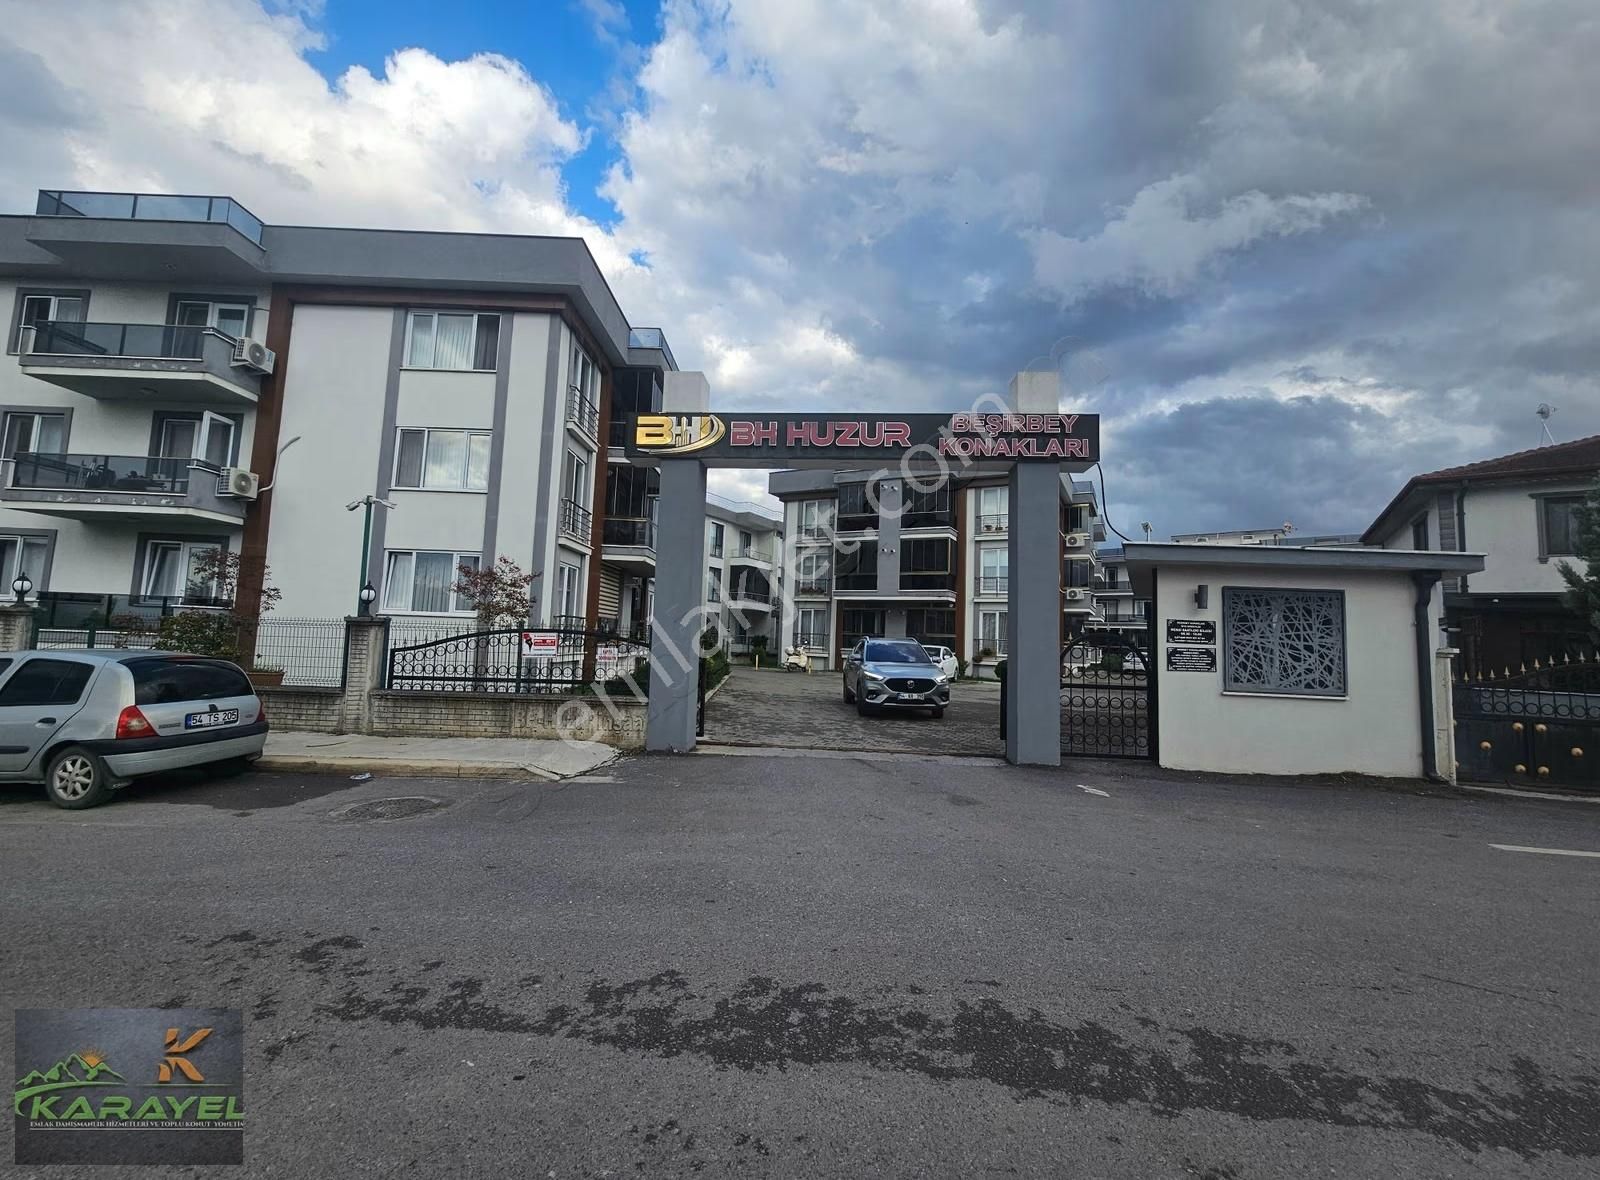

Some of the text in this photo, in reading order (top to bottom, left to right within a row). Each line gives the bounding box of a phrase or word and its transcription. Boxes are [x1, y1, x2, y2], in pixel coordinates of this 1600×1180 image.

[730, 420, 911, 447] BH HUZUR
[939, 437, 1089, 457] KONAKLARI
[192, 714, 203, 725] 54
[208, 712, 220, 723] TS
